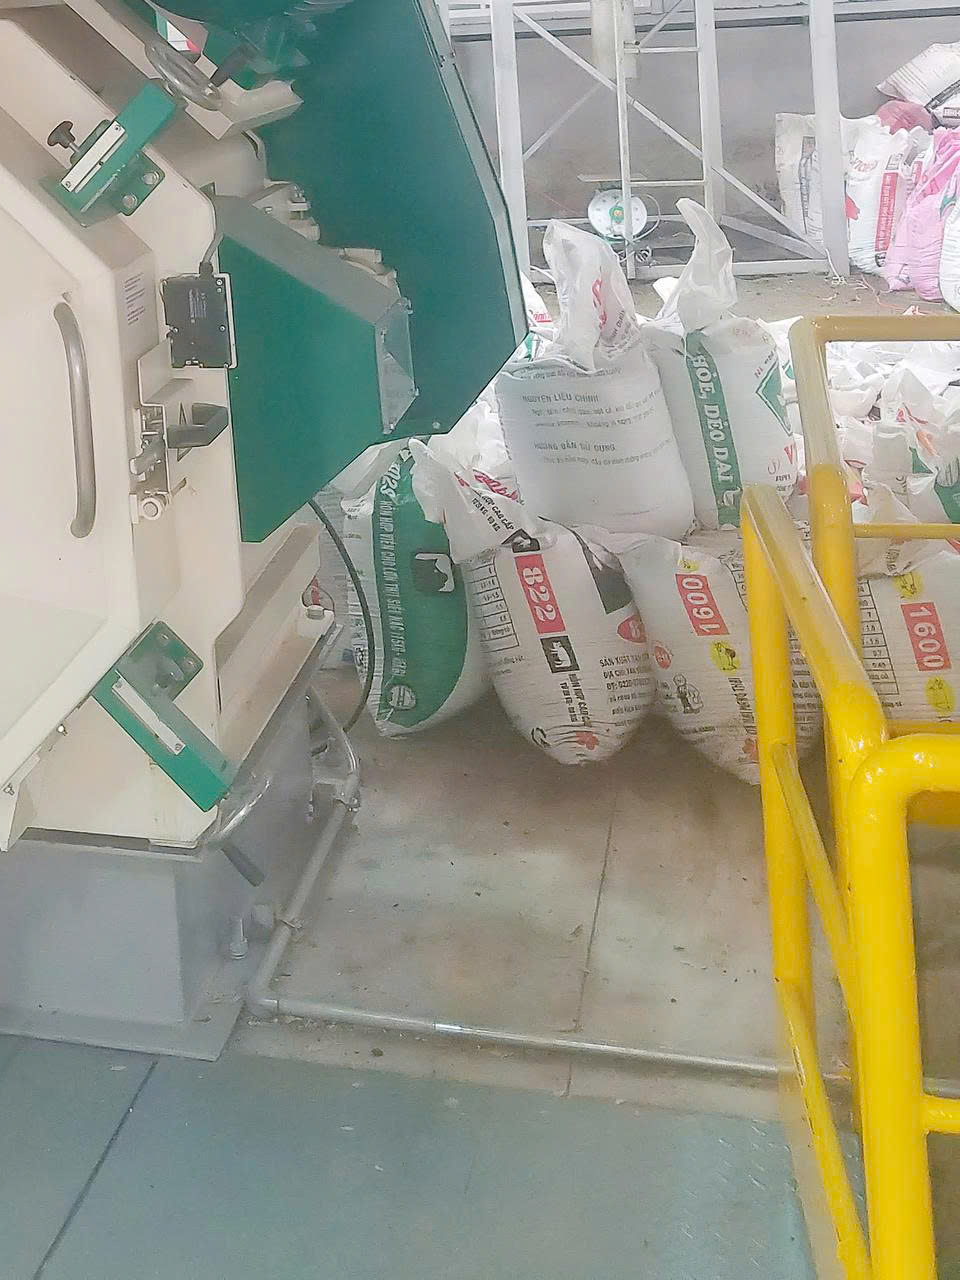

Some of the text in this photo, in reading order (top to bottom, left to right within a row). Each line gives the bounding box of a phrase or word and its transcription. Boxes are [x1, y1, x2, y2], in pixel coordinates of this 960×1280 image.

[521, 566, 557, 623] 822
[681, 576, 721, 633] 1600
[910, 606, 945, 670] 1600
